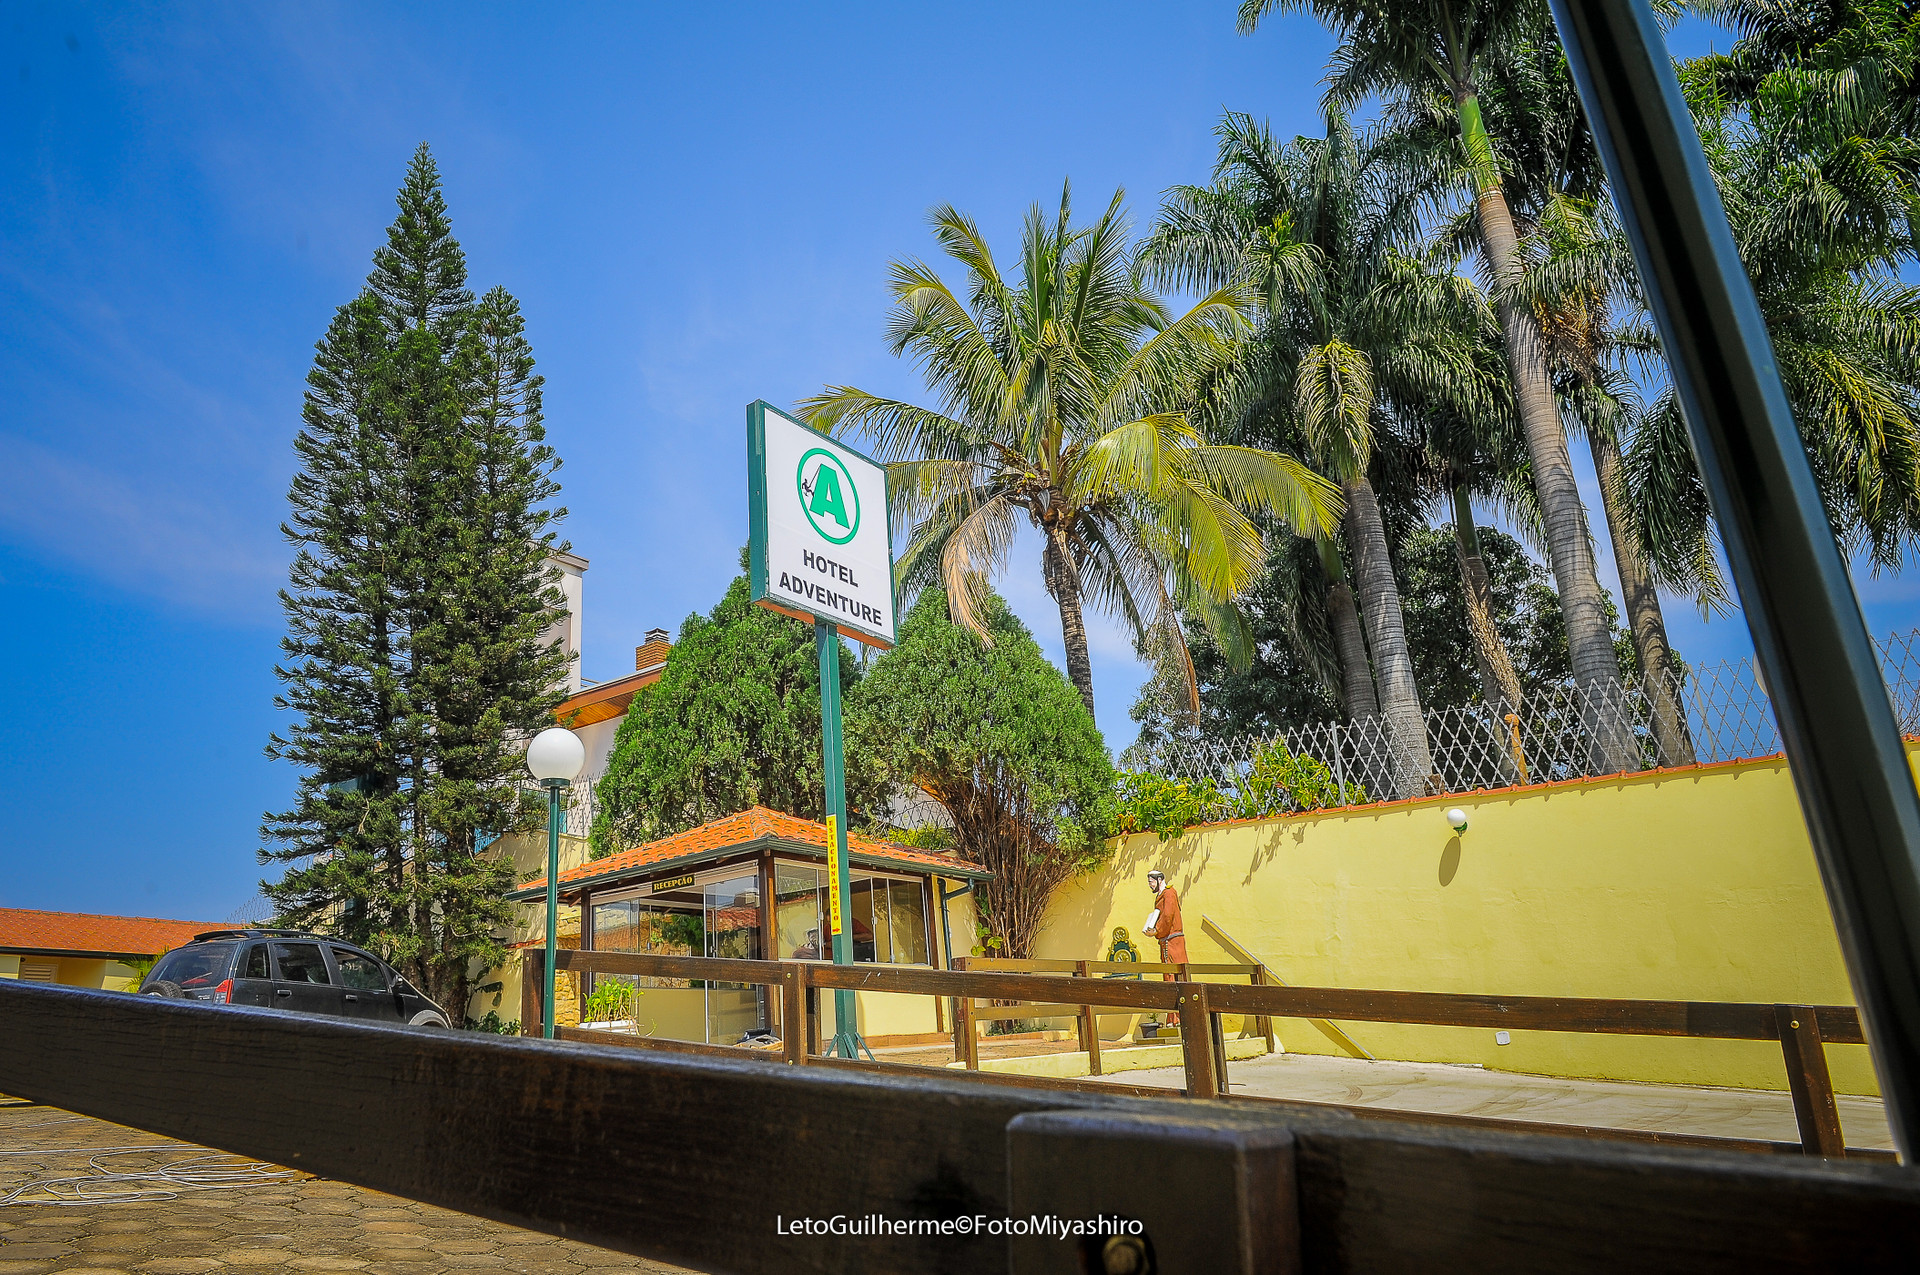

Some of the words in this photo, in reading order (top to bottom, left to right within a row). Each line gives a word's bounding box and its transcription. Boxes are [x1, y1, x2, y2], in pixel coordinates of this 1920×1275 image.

[809, 463, 850, 530] A
[803, 549, 858, 588] HOTEL
[779, 572, 882, 626] ADVENTURE
[828, 820, 839, 921] ESTACIONAMENTO
